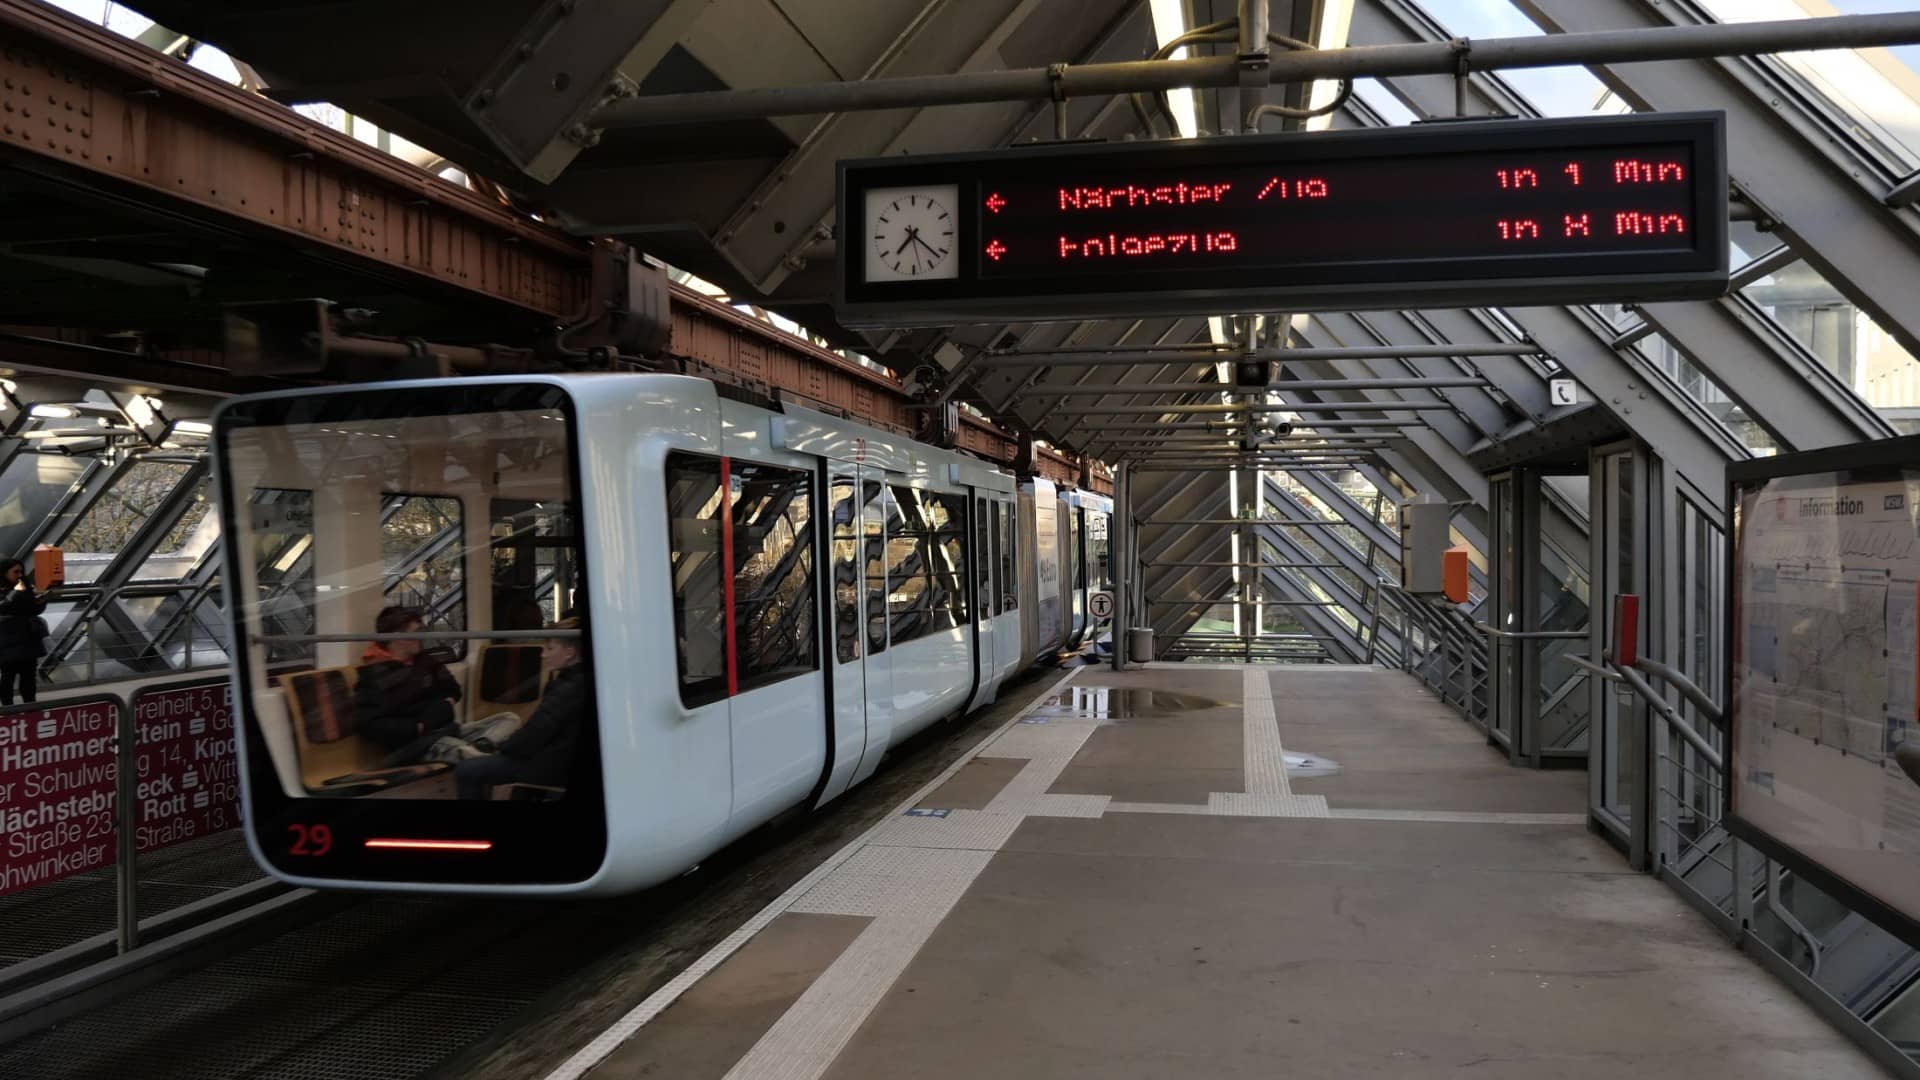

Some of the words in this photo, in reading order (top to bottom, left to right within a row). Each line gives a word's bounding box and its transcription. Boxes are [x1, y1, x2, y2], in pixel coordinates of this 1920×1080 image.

[1800, 496, 1864, 518] Information
[61, 710, 101, 736] Alte
[8, 820, 82, 858] Straße
[143, 793, 187, 822] Rott
[135, 817, 196, 850] Straße
[287, 823, 332, 857] 29
